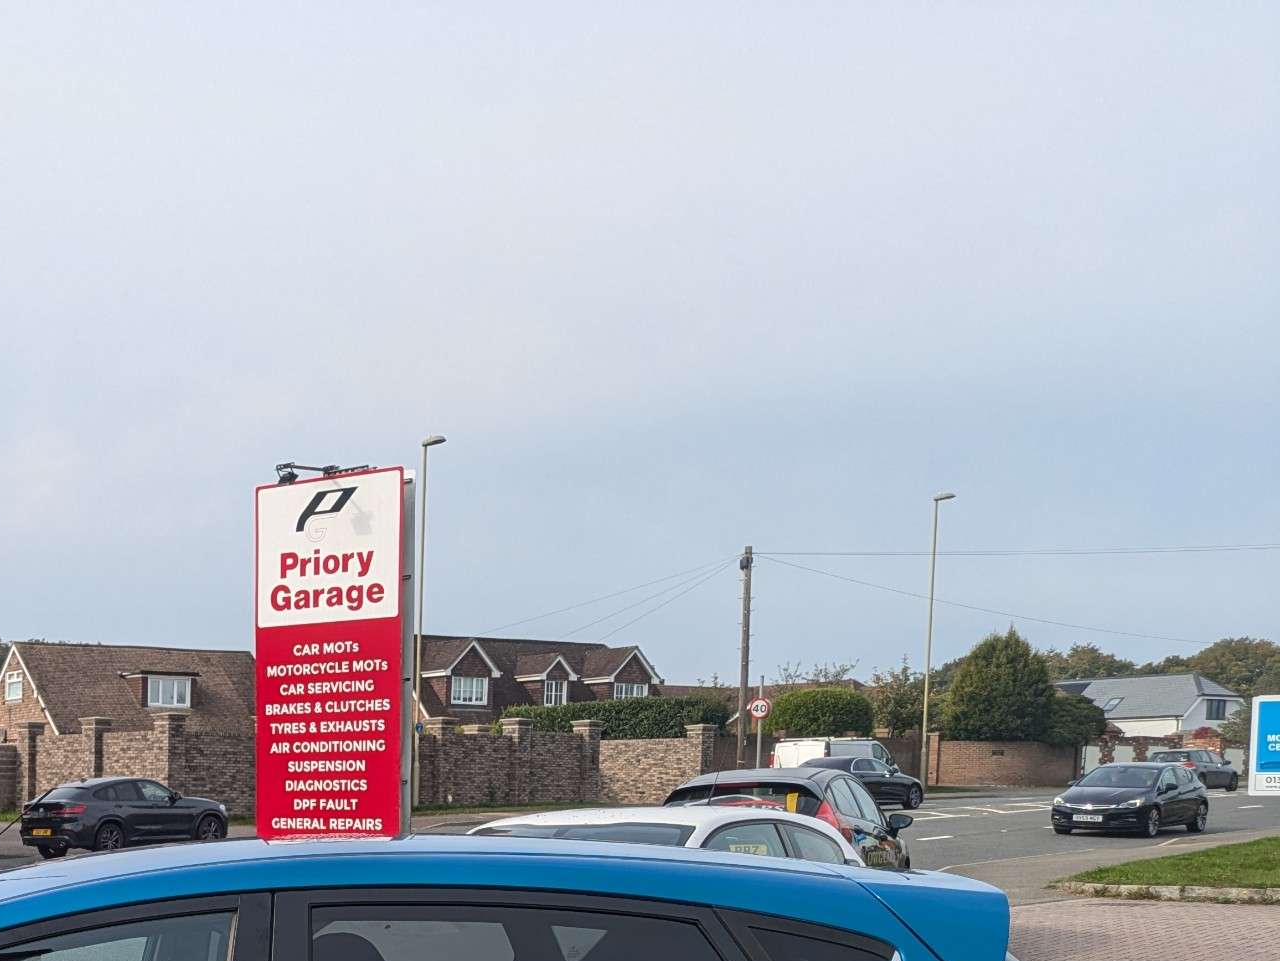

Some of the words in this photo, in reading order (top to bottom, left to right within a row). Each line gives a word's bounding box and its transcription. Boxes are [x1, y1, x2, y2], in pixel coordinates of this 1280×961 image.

[280, 549, 374, 579] Priory
[270, 582, 384, 611] Garage
[293, 644, 319, 656] CAR
[323, 641, 359, 654] MOTs
[267, 662, 349, 677] MOTORCYCLE
[353, 660, 388, 672] MOTs
[280, 684, 304, 695] CAR
[308, 680, 374, 694] SERVICING
[265, 703, 311, 715] BRAKES
[325, 699, 390, 713] CLUTCHES
[752, 704, 767, 713] 40
[270, 722, 306, 734] TYRES
[320, 720, 385, 733] EXHAUSTS
[270, 742, 290, 753] AIR
[293, 740, 385, 753] CONDITIONING
[288, 760, 365, 772] SUSPENSION
[286, 780, 367, 791] DIAGNOSTICS
[294, 799, 316, 810] DPF
[320, 799, 358, 810] FAULT
[272, 818, 326, 829] GENERAL
[330, 819, 382, 830] REPAIRS
